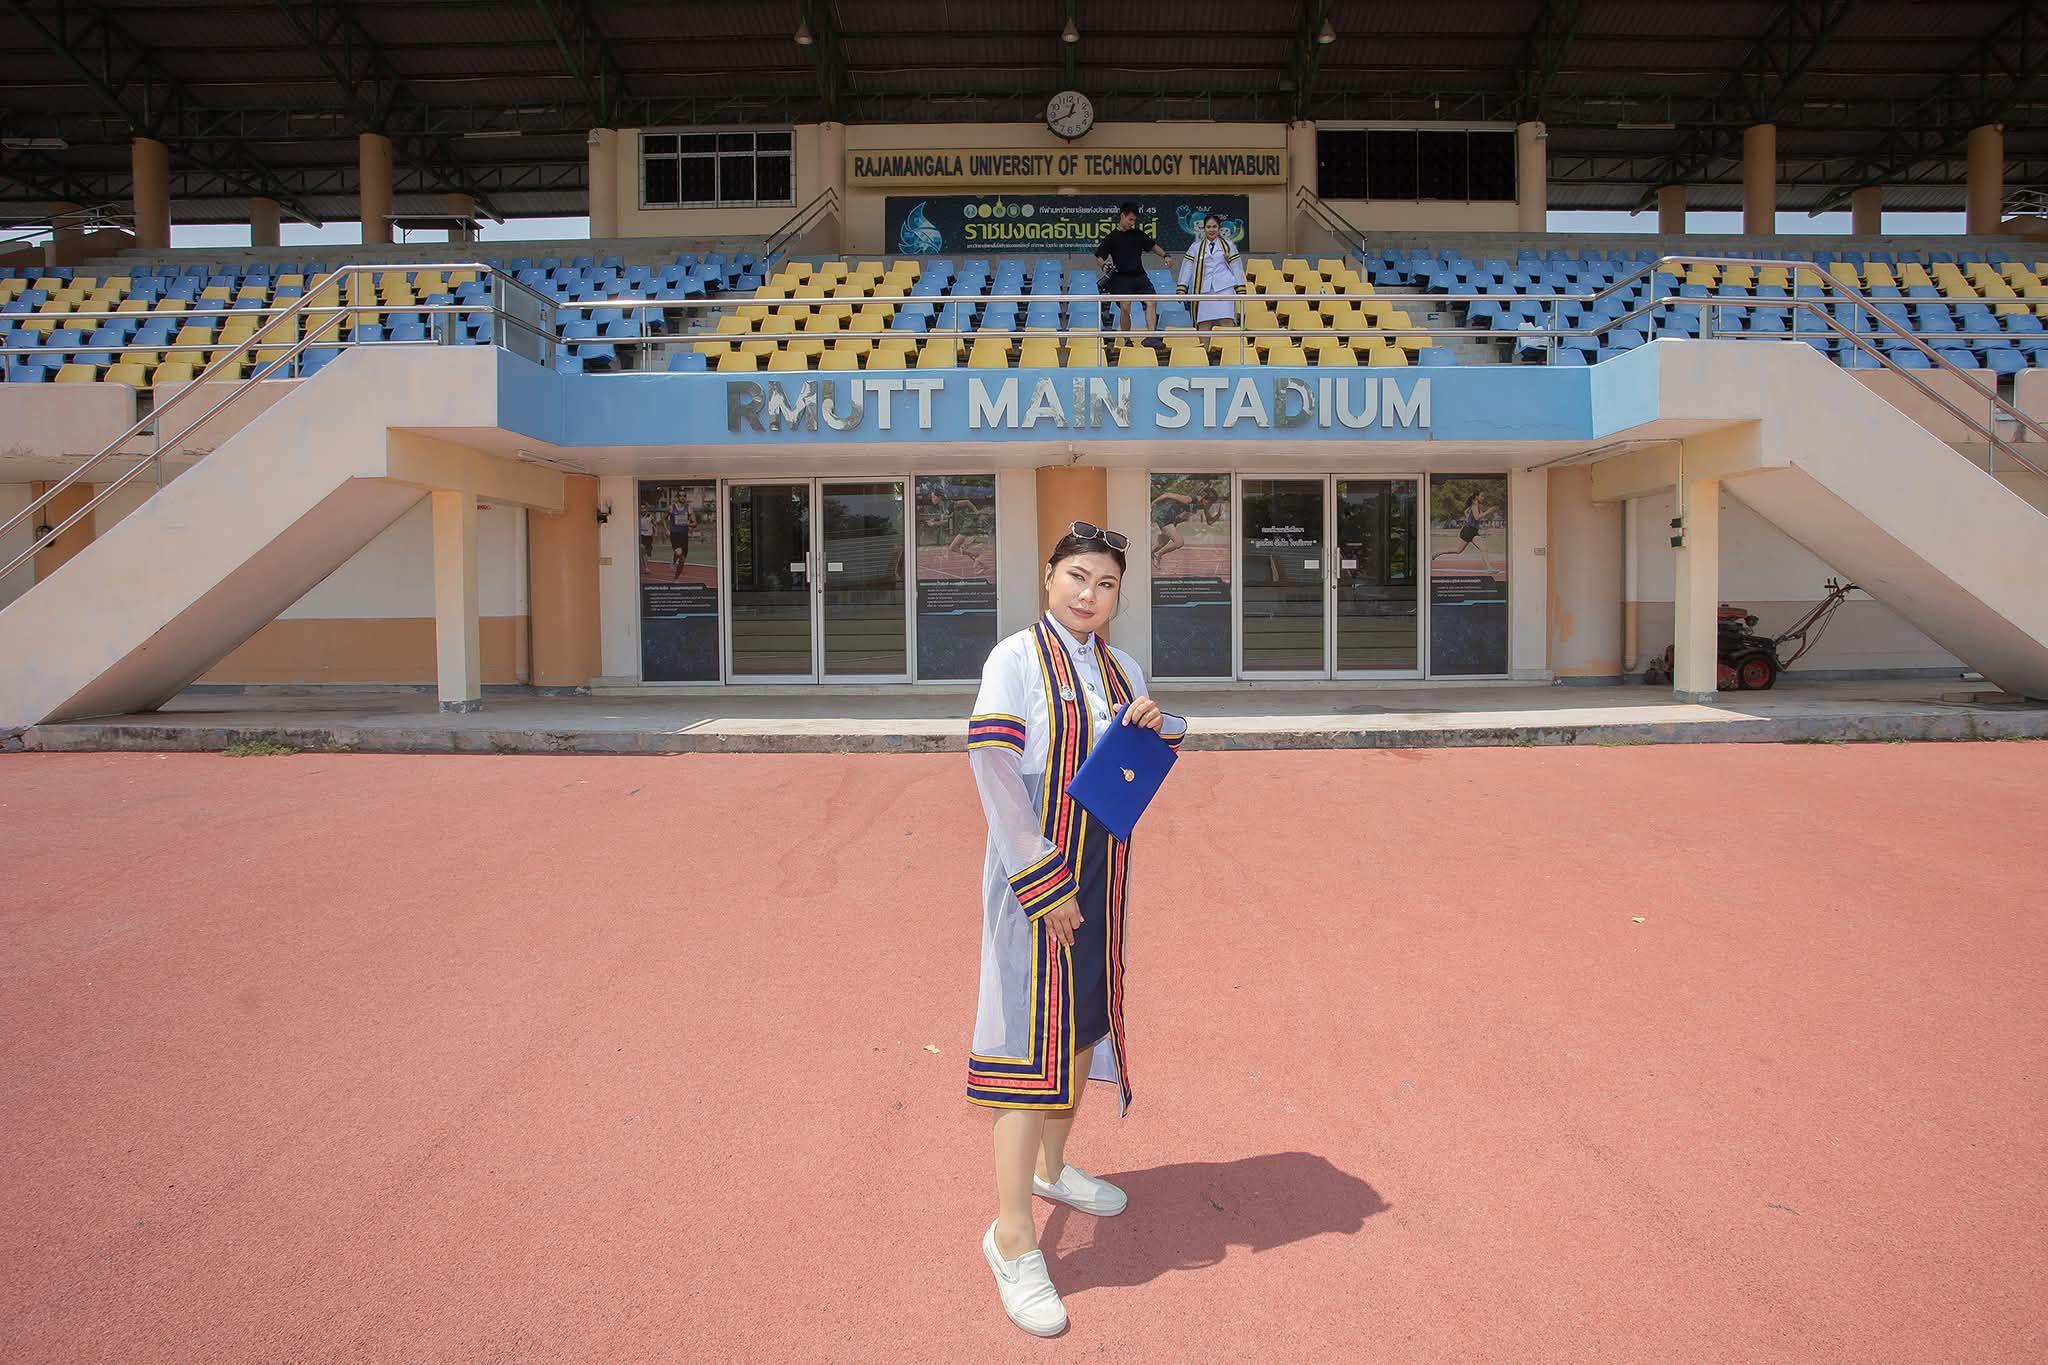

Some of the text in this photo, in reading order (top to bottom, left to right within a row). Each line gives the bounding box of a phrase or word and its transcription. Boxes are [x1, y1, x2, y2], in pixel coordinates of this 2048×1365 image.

[854, 154, 1280, 177] RAJAMANGALA UNIVERSITY OF TECHNOLOGY THANYABURI
[1039, 205, 1121, 214] กีฬามหาวิทยาลัยแห่งประเทศไท
[1146, 206, 1157, 214] 45
[964, 216, 1158, 243] ราชมงคลธัญบุรีส์
[727, 376, 1431, 432] RMUTT MAIN STADIUM
